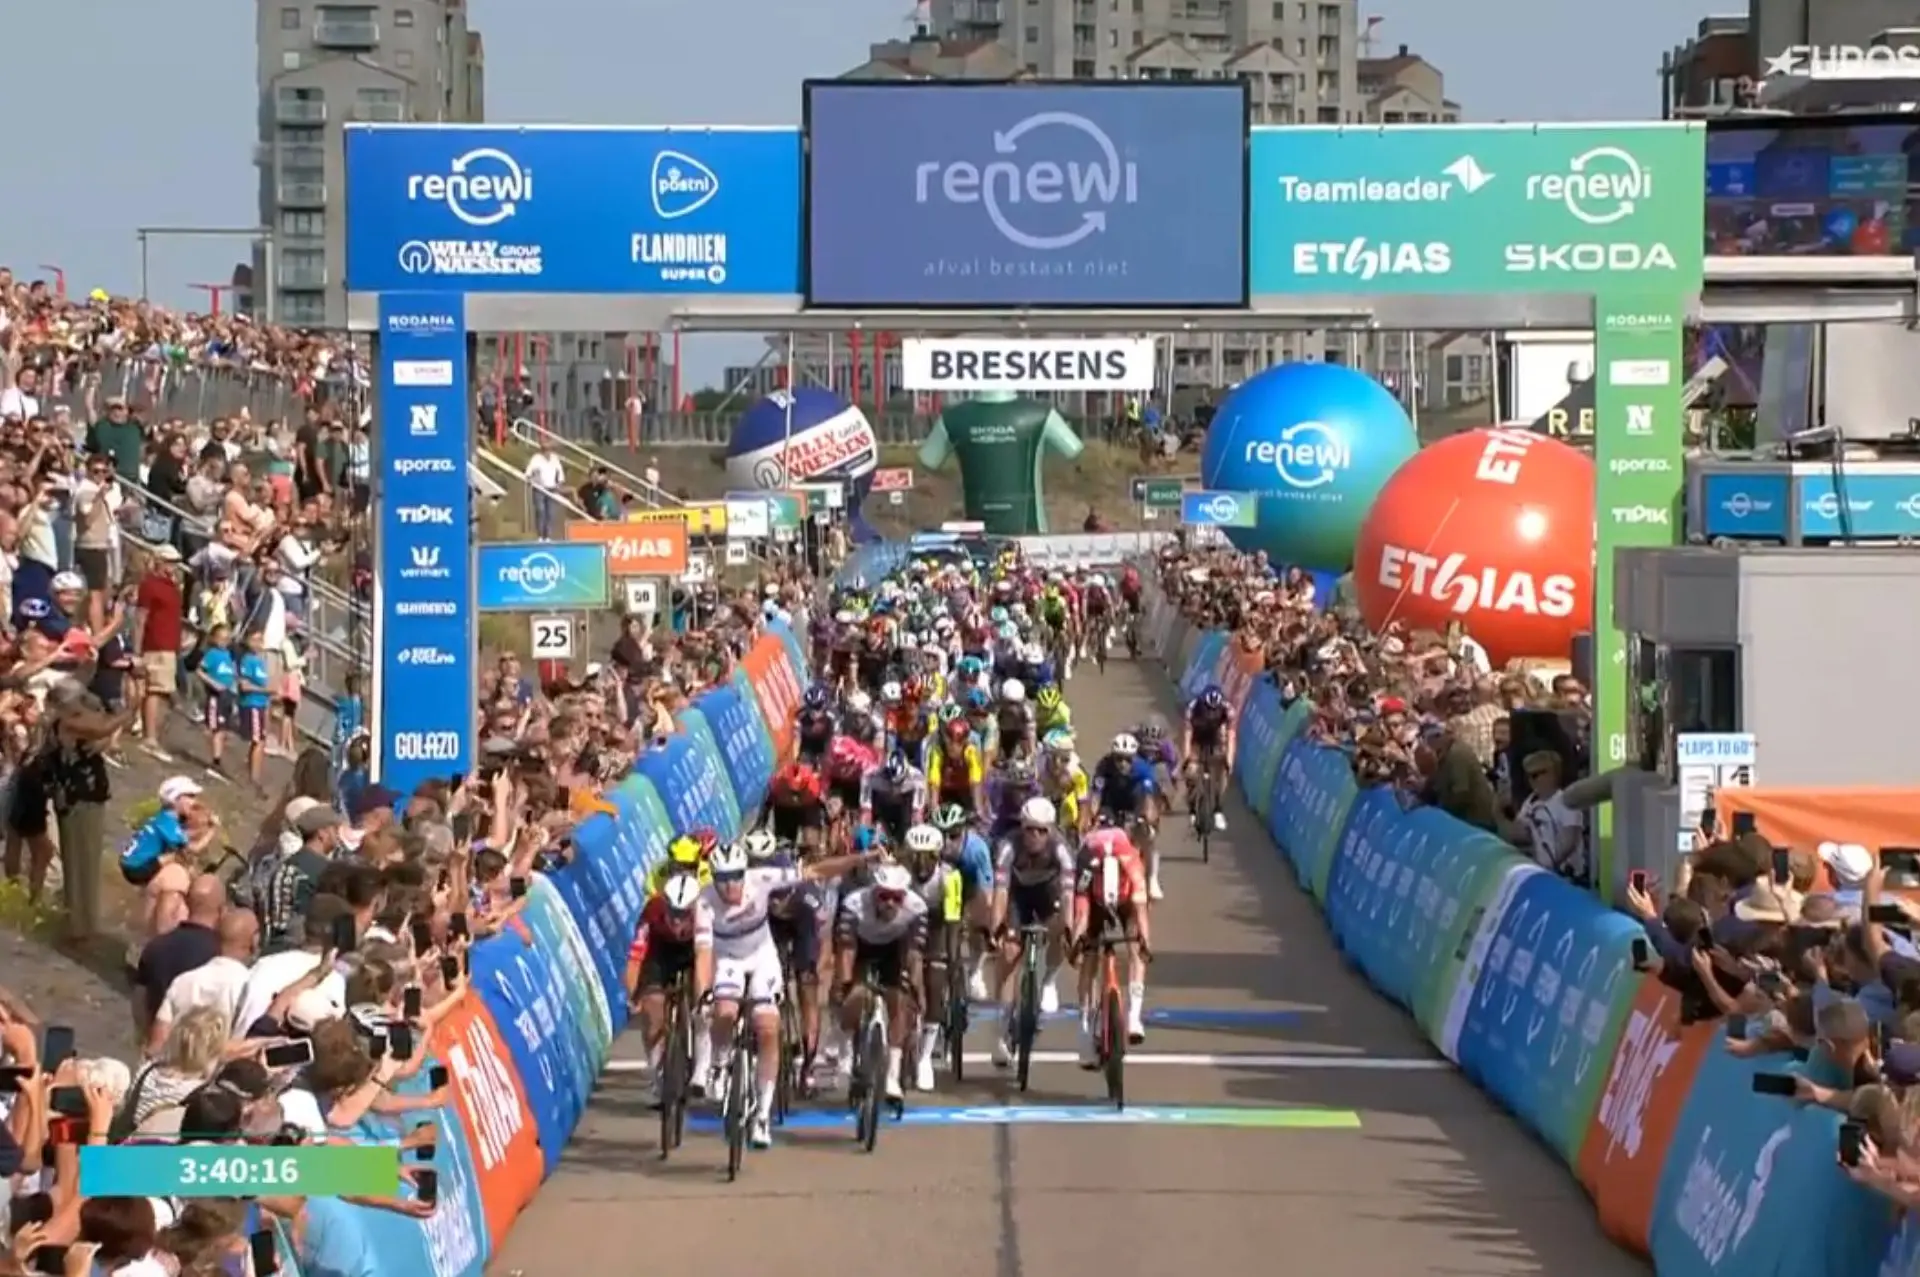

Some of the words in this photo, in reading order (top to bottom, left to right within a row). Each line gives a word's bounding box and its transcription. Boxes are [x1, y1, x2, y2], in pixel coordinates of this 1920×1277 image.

[408, 169, 532, 201] renewi
[916, 158, 1139, 204] renewi
[1279, 175, 1452, 202] Teamleader
[1526, 168, 1652, 200] renewi
[428, 239, 498, 257] WILLY
[631, 232, 727, 264] FLANDRIEN
[923, 257, 979, 276] afval
[989, 257, 1075, 276] bestaat
[1083, 257, 1130, 276] niet
[387, 315, 455, 326] RODANIA
[930, 350, 1128, 380] BRESKENS
[410, 403, 438, 430] N
[1626, 404, 1654, 430] N
[537, 626, 568, 648] 25
[395, 731, 459, 760] GOLAZO
